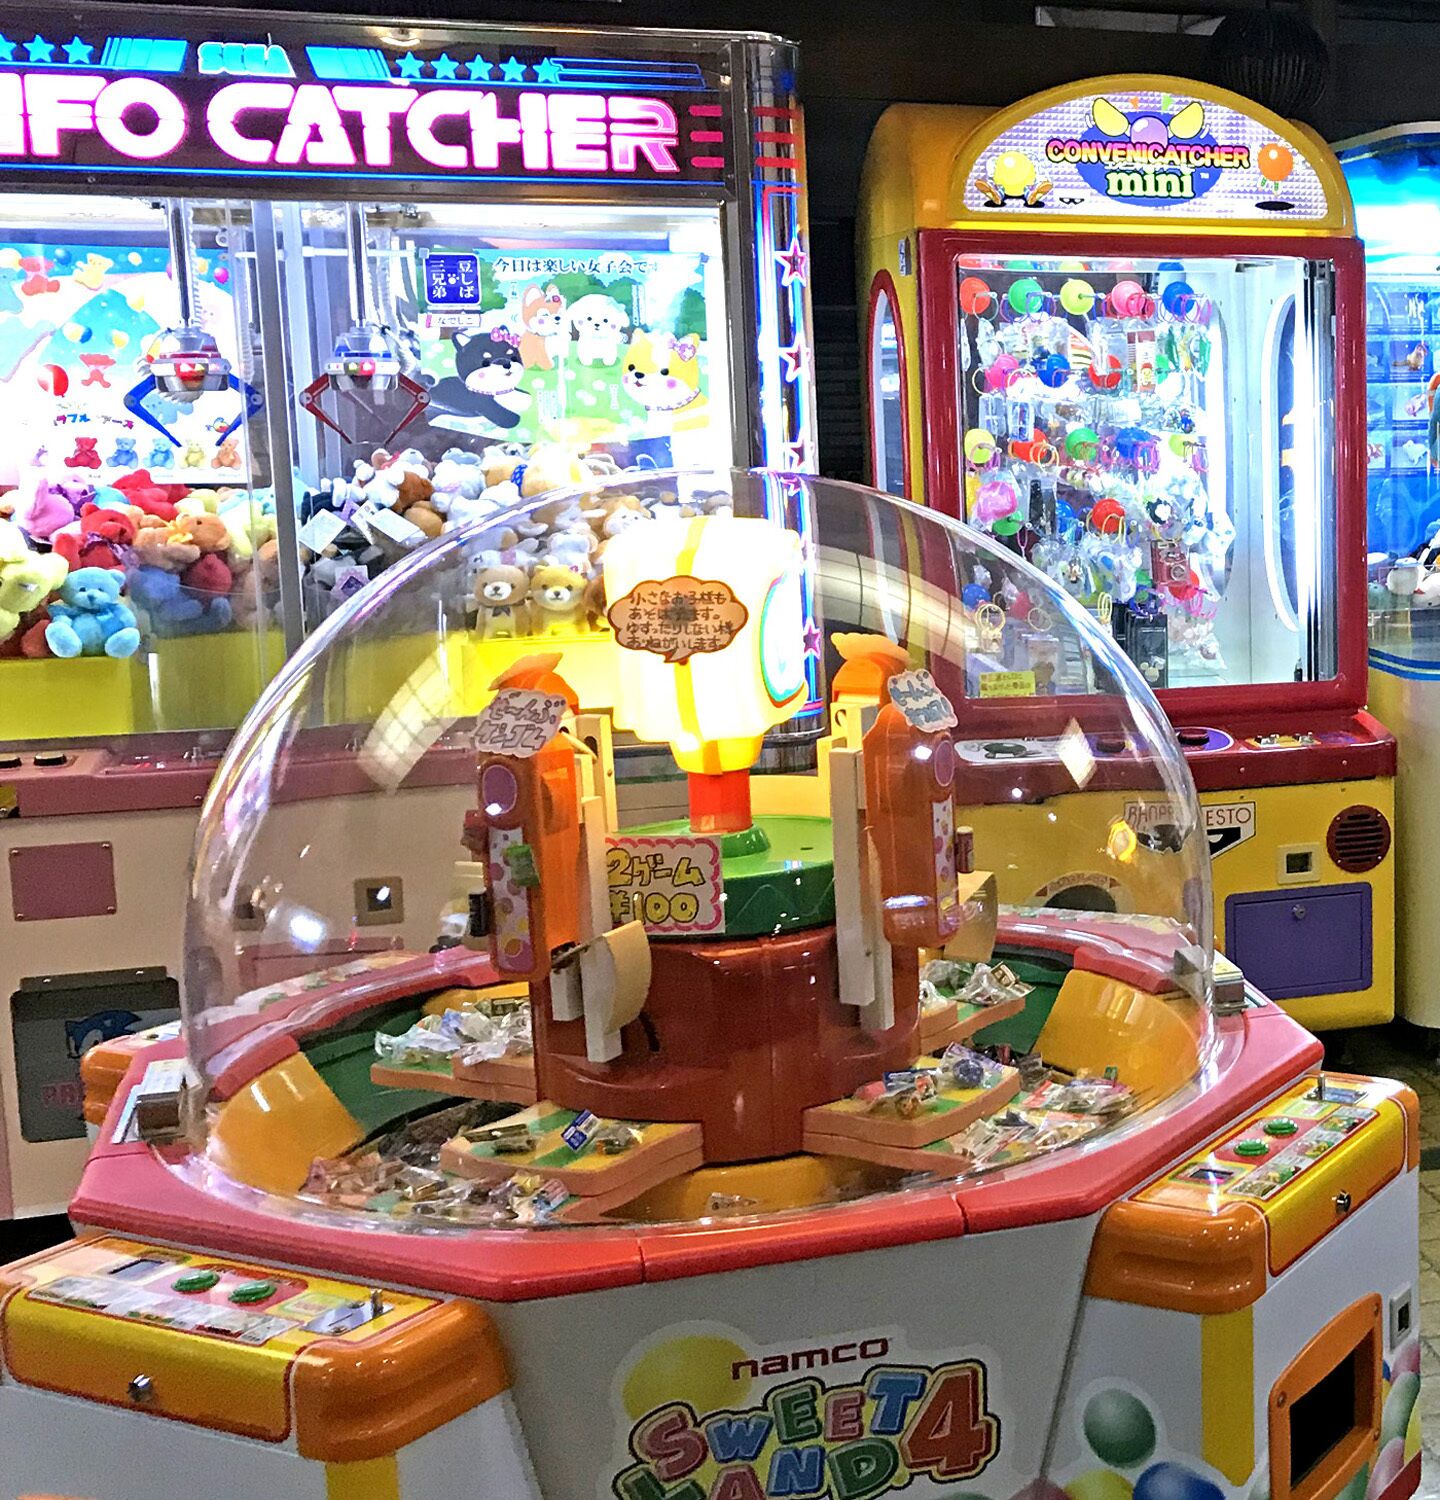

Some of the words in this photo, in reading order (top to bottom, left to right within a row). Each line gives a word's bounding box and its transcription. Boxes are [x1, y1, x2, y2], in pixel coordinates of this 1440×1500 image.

[206, 81, 681, 173] CATCHER
[1046, 139, 1251, 169] CONVENICATCHER
[1105, 170, 1196, 198] mini
[429, 258, 447, 299] 三兄弟
[457, 258, 475, 299] 豆しば
[628, 606, 720, 621] あそばます。
[606, 847, 706, 888] 2ゲーム
[731, 1337, 890, 1380] namco
[612, 1438, 900, 1500] LAND
[900, 1362, 1000, 1482] 4
[634, 1366, 930, 1481] SWEET
